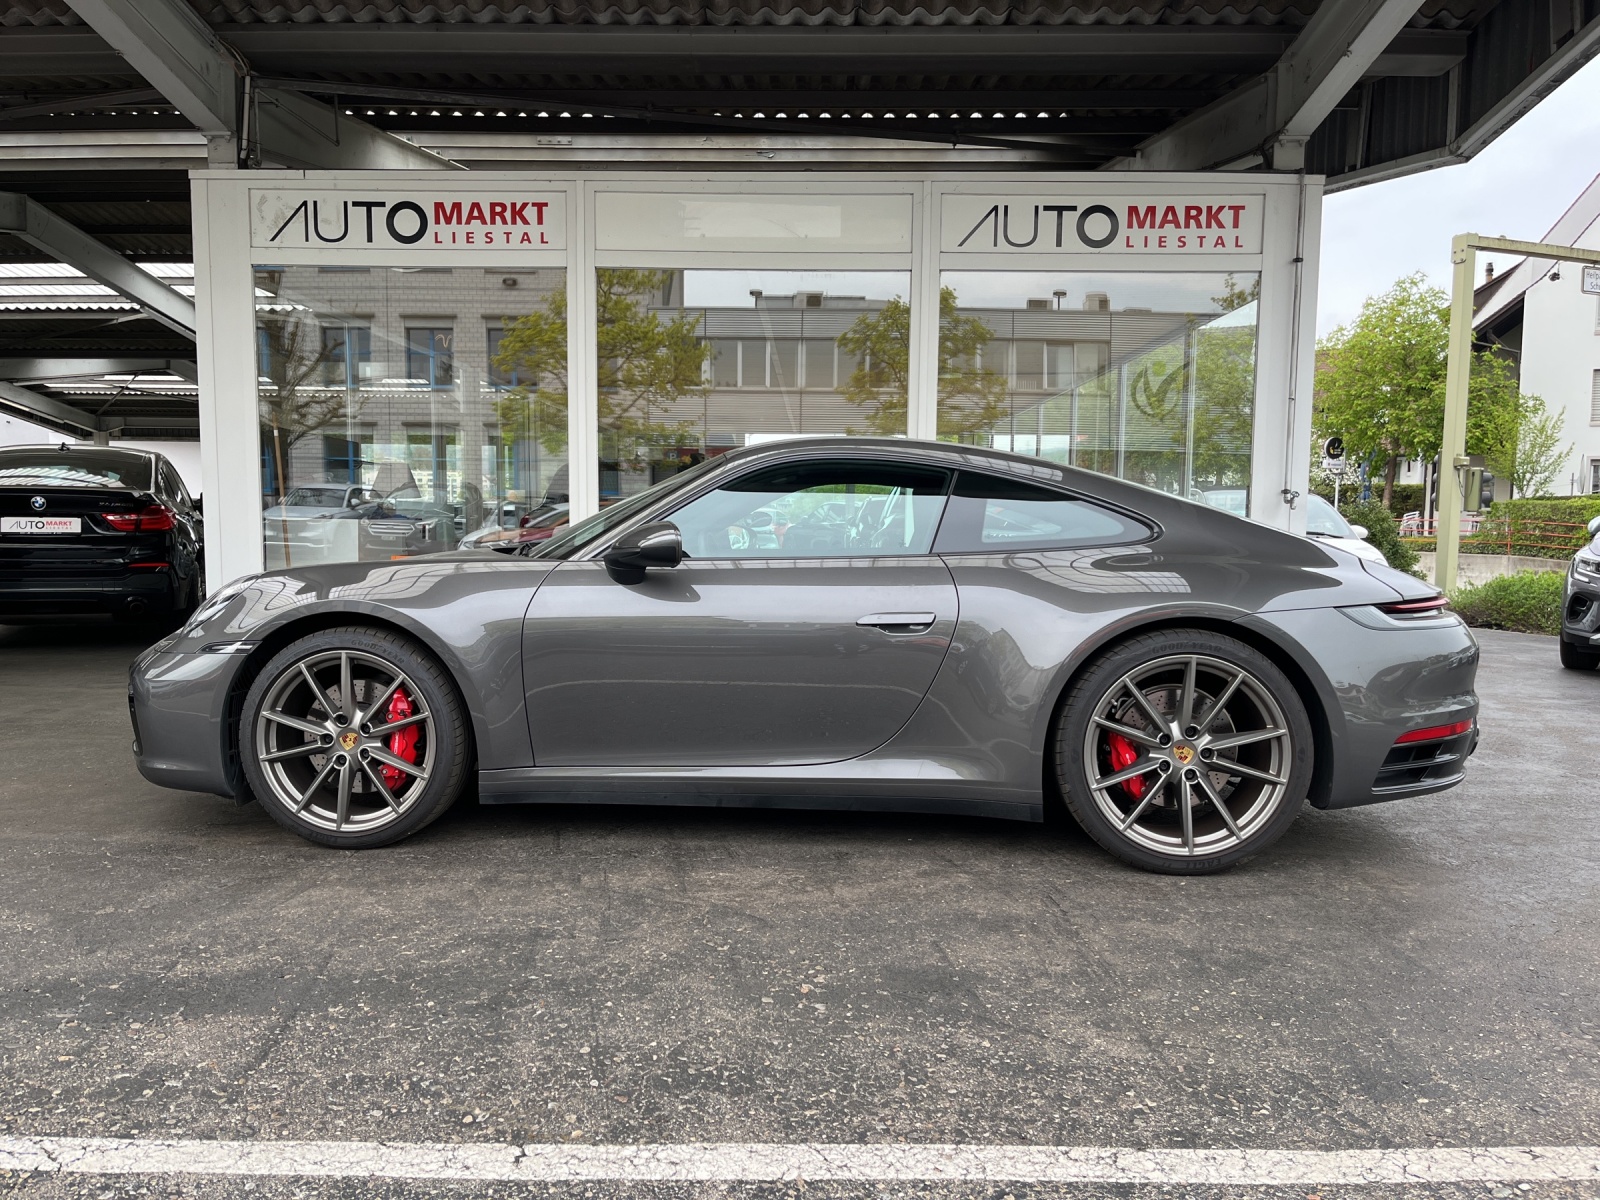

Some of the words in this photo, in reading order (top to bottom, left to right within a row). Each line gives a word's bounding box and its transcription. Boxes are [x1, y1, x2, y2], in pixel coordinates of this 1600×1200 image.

[269, 200, 428, 245] AUTO
[433, 201, 549, 226] MARKT
[957, 204, 1119, 248] AUTO
[1126, 205, 1245, 229] MARKT
[434, 231, 549, 244] LIESTAL
[1126, 235, 1244, 248] LIESTAL
[9, 520, 45, 530] AUTO
